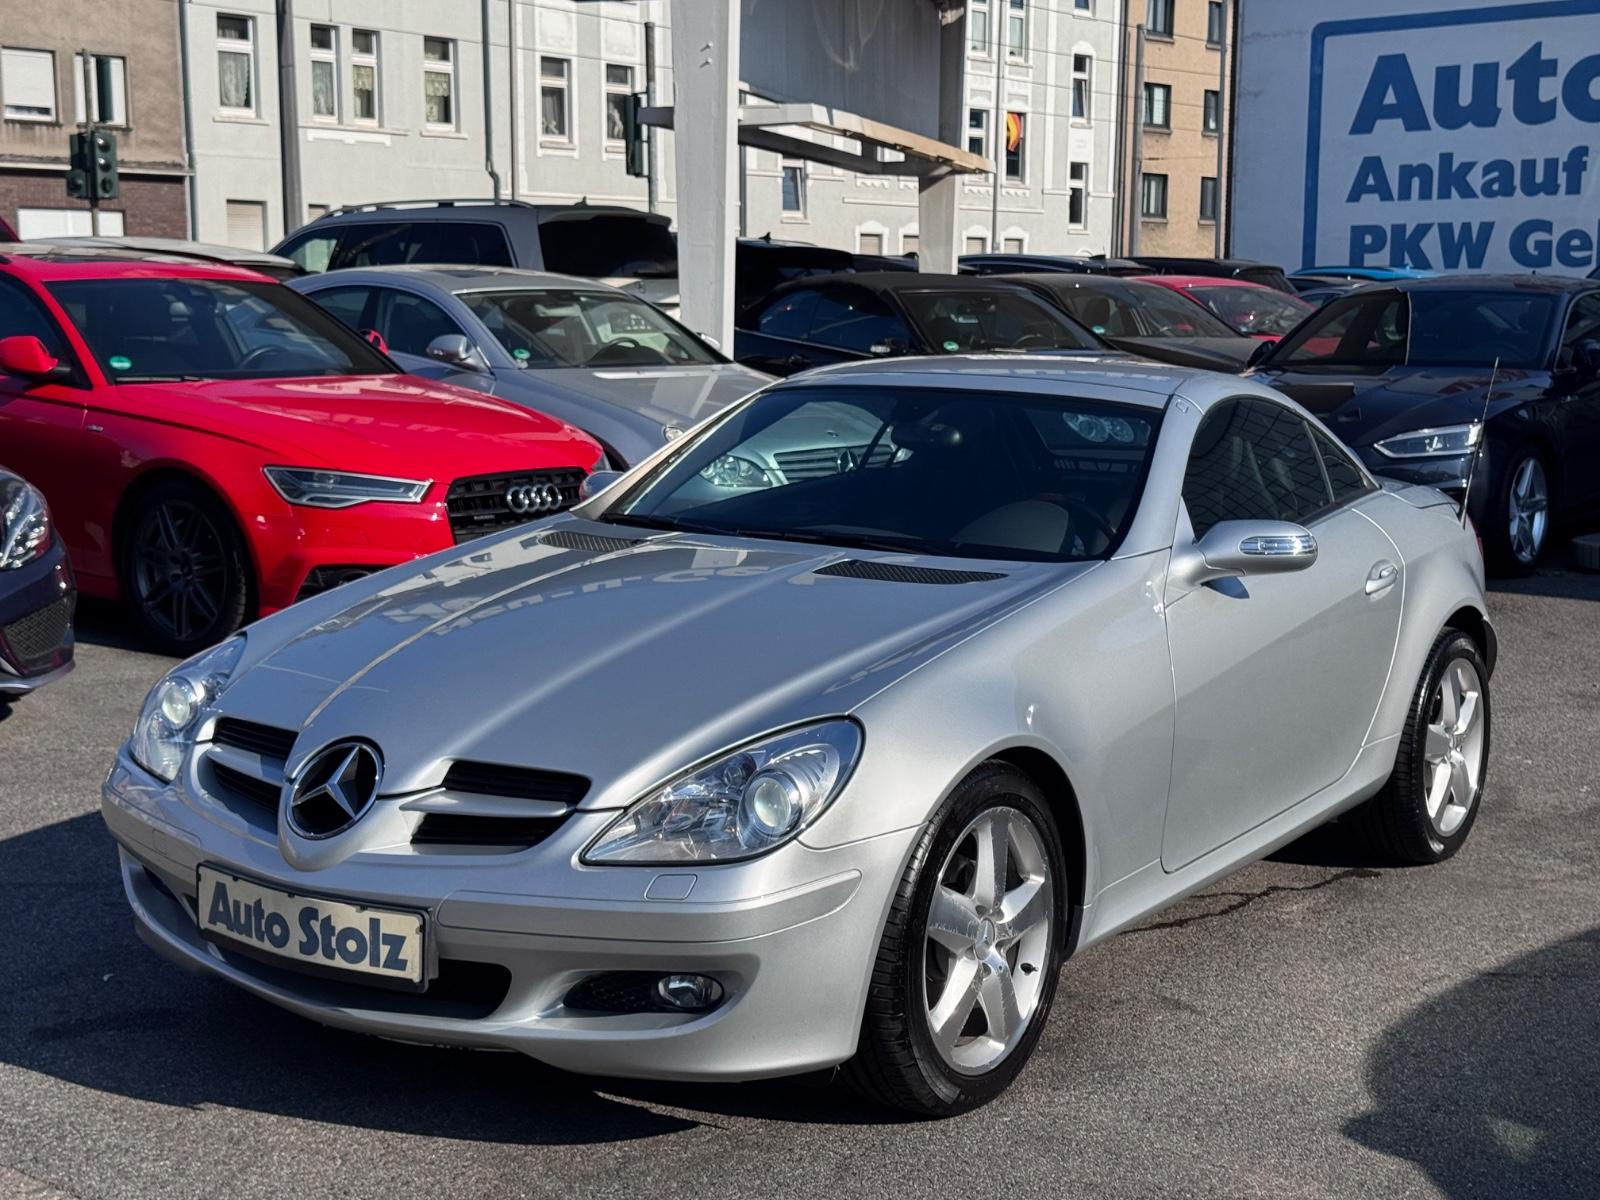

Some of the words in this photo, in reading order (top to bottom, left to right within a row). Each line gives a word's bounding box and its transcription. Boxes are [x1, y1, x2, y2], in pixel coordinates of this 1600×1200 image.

[1346, 145, 1589, 203] Ankauf
[1350, 221, 1495, 269] PKW
[1508, 218, 1600, 270] Ge
[208, 881, 290, 949] Auto
[299, 906, 408, 972] Stolz
